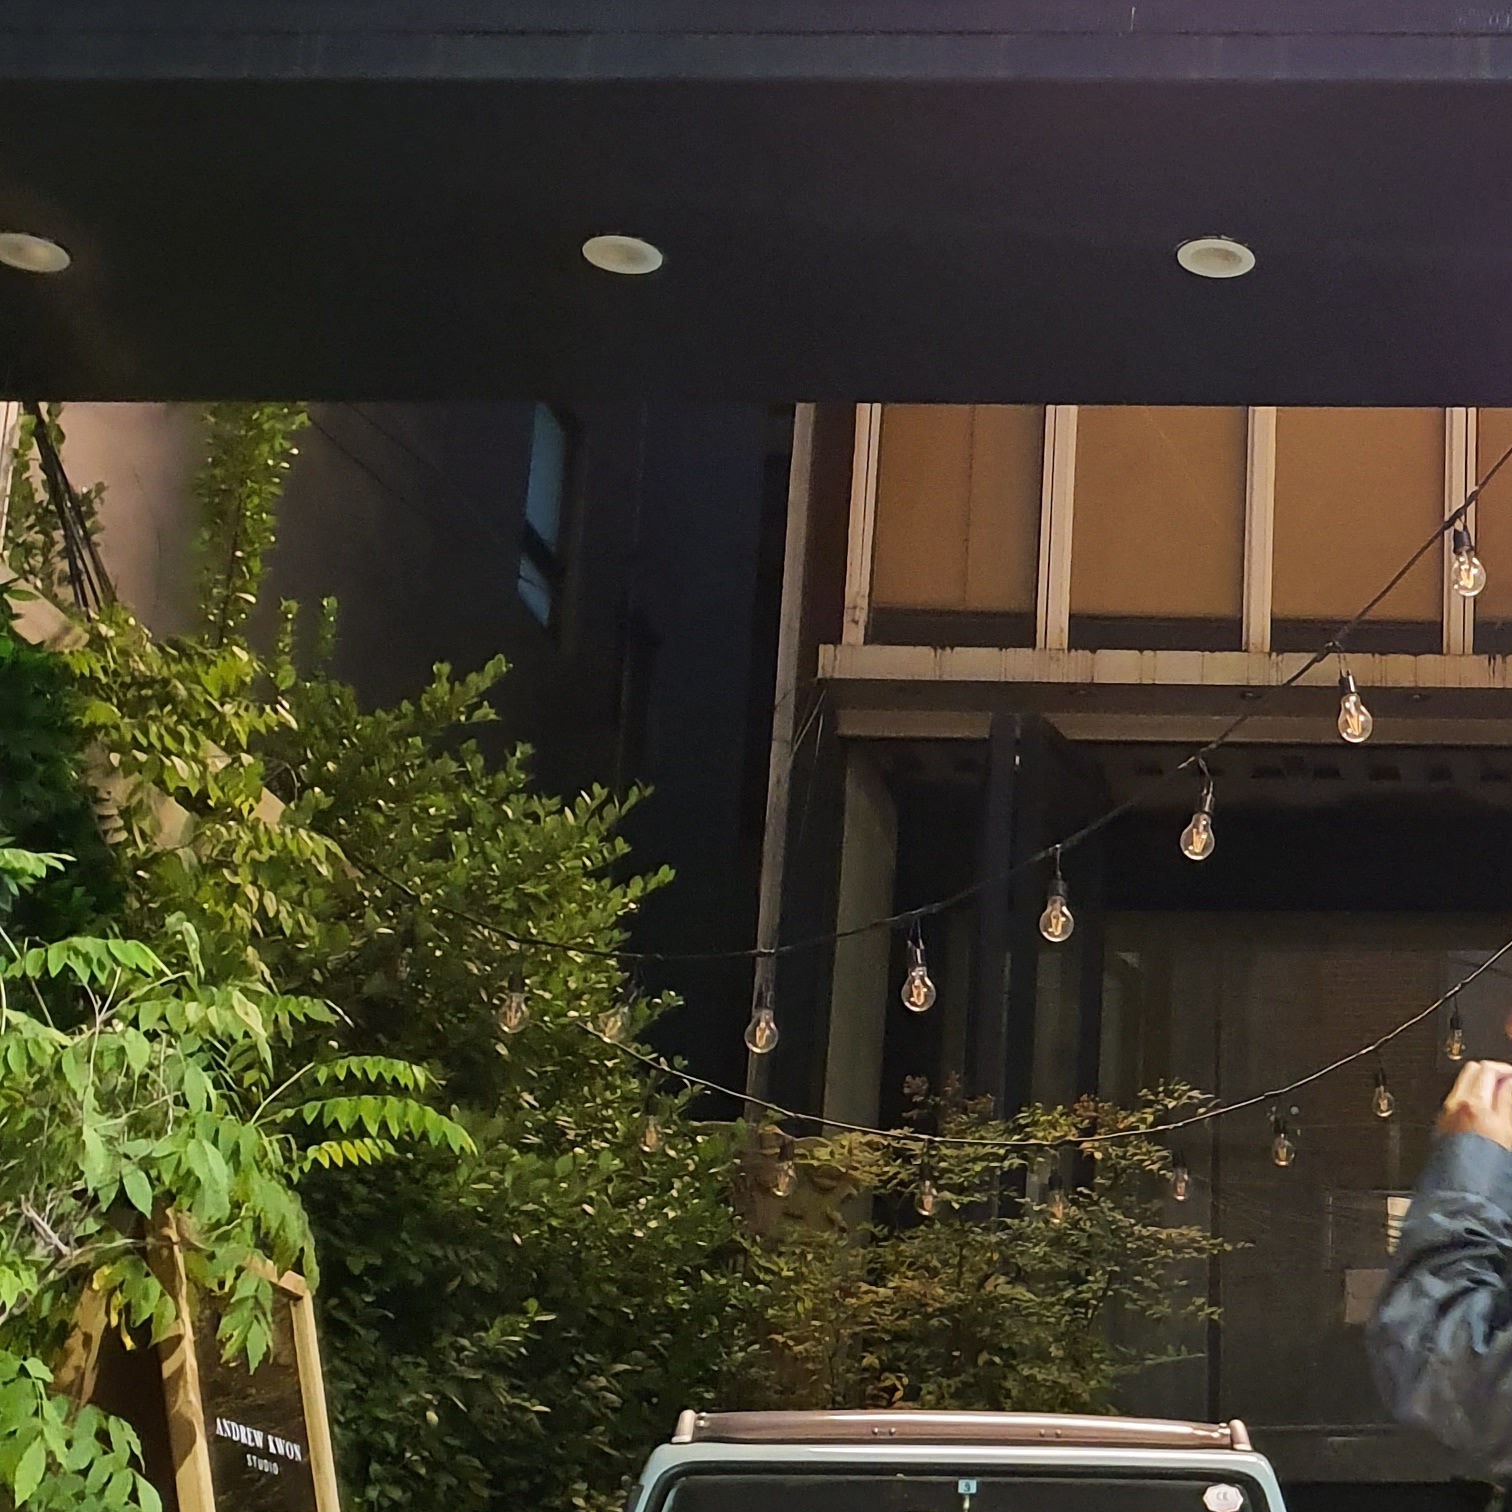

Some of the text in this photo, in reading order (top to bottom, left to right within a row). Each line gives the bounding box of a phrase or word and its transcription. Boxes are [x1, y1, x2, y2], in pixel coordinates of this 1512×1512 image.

[216, 1417, 302, 1461] ANDREW KWON
[246, 1453, 279, 1475] STUDIO
